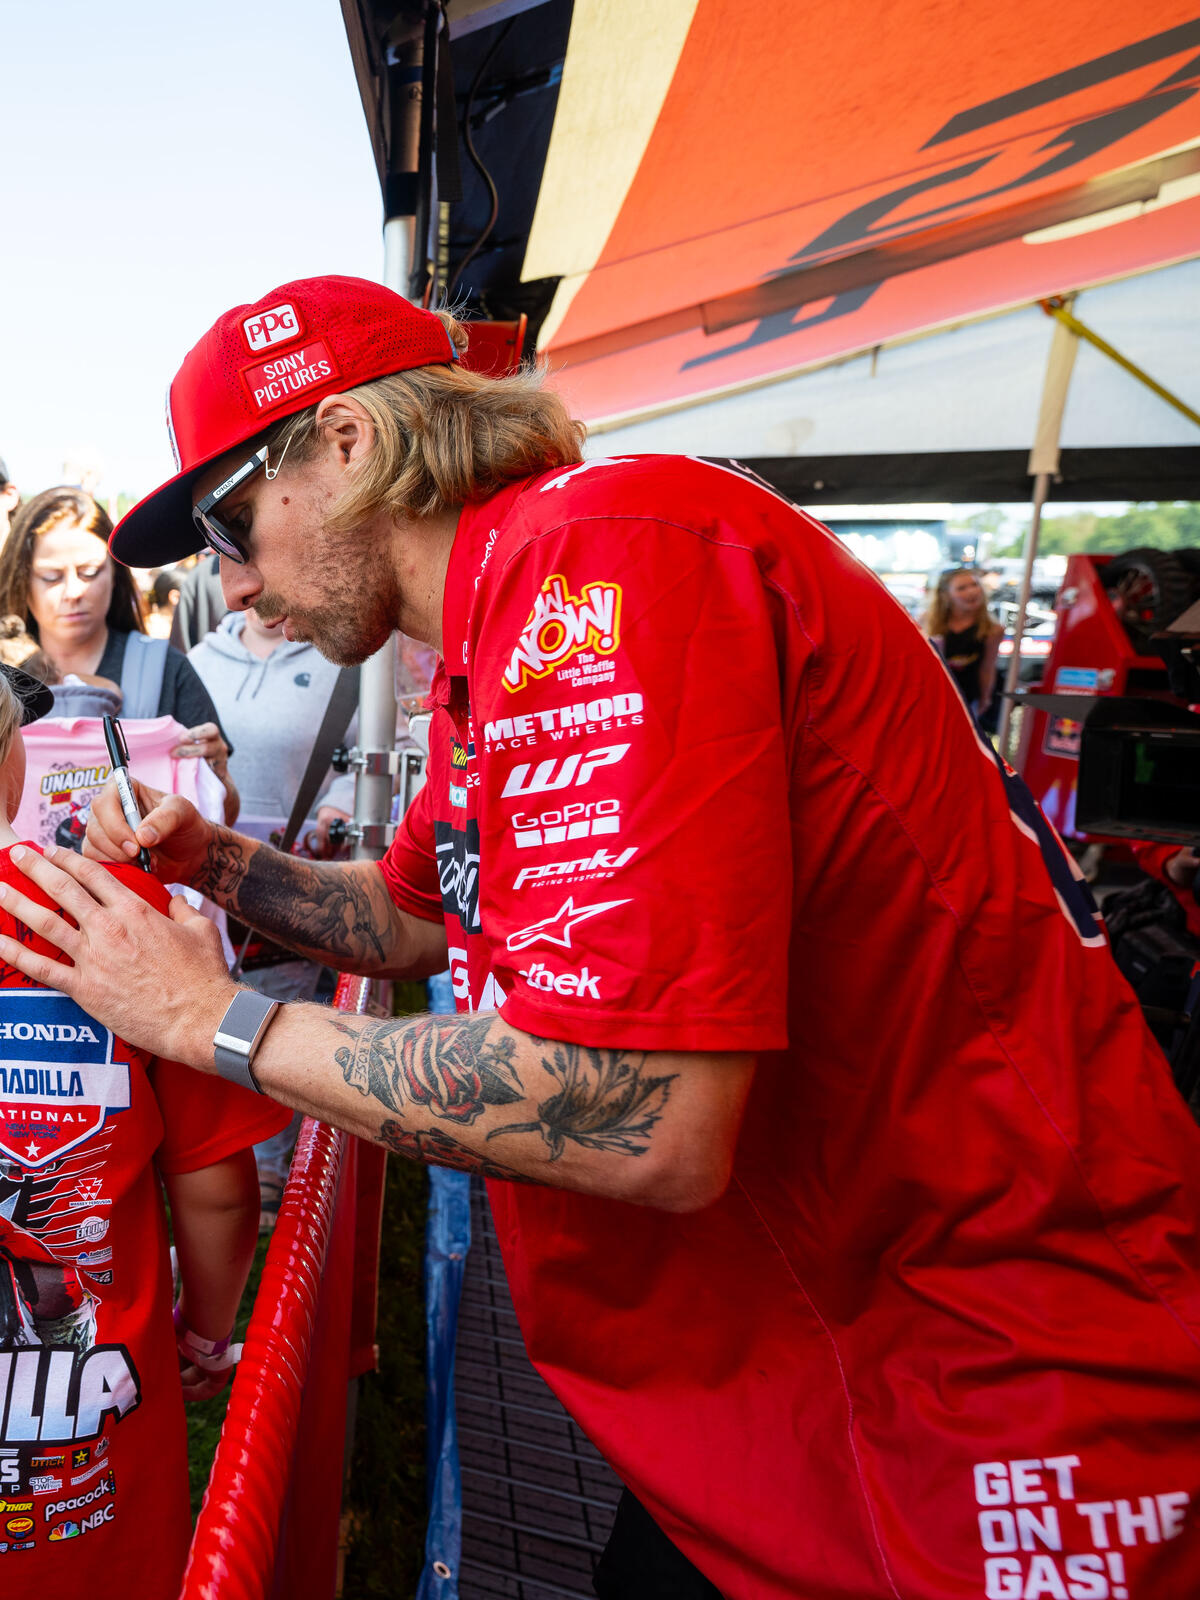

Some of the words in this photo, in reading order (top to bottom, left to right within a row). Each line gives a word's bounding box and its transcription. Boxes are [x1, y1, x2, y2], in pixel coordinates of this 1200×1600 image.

[247, 310, 294, 342] PPG
[263, 350, 306, 381] SONY
[253, 360, 332, 408] PICTURES
[557, 667, 581, 681] Little
[582, 659, 615, 675] Waffle
[577, 652, 595, 664] The
[571, 670, 615, 687] Company
[484, 692, 644, 743] METHOD
[550, 715, 644, 742] WHEELS
[500, 743, 632, 799] WP
[511, 799, 620, 830] GoPro
[5, 1122, 27, 1131] NEW
[8, 1130, 30, 1138] NEW
[32, 1131, 59, 1140] YORK
[29, 1476, 54, 1485] STOP
[973, 1454, 1081, 1506] GET
[5, 1502, 33, 1512] THOR
[45, 1478, 111, 1522] peacock
[80, 1503, 115, 1534] NBC
[977, 1505, 1062, 1554] ON
[1075, 1491, 1190, 1549] THE
[984, 1551, 1129, 1600] GAS!
